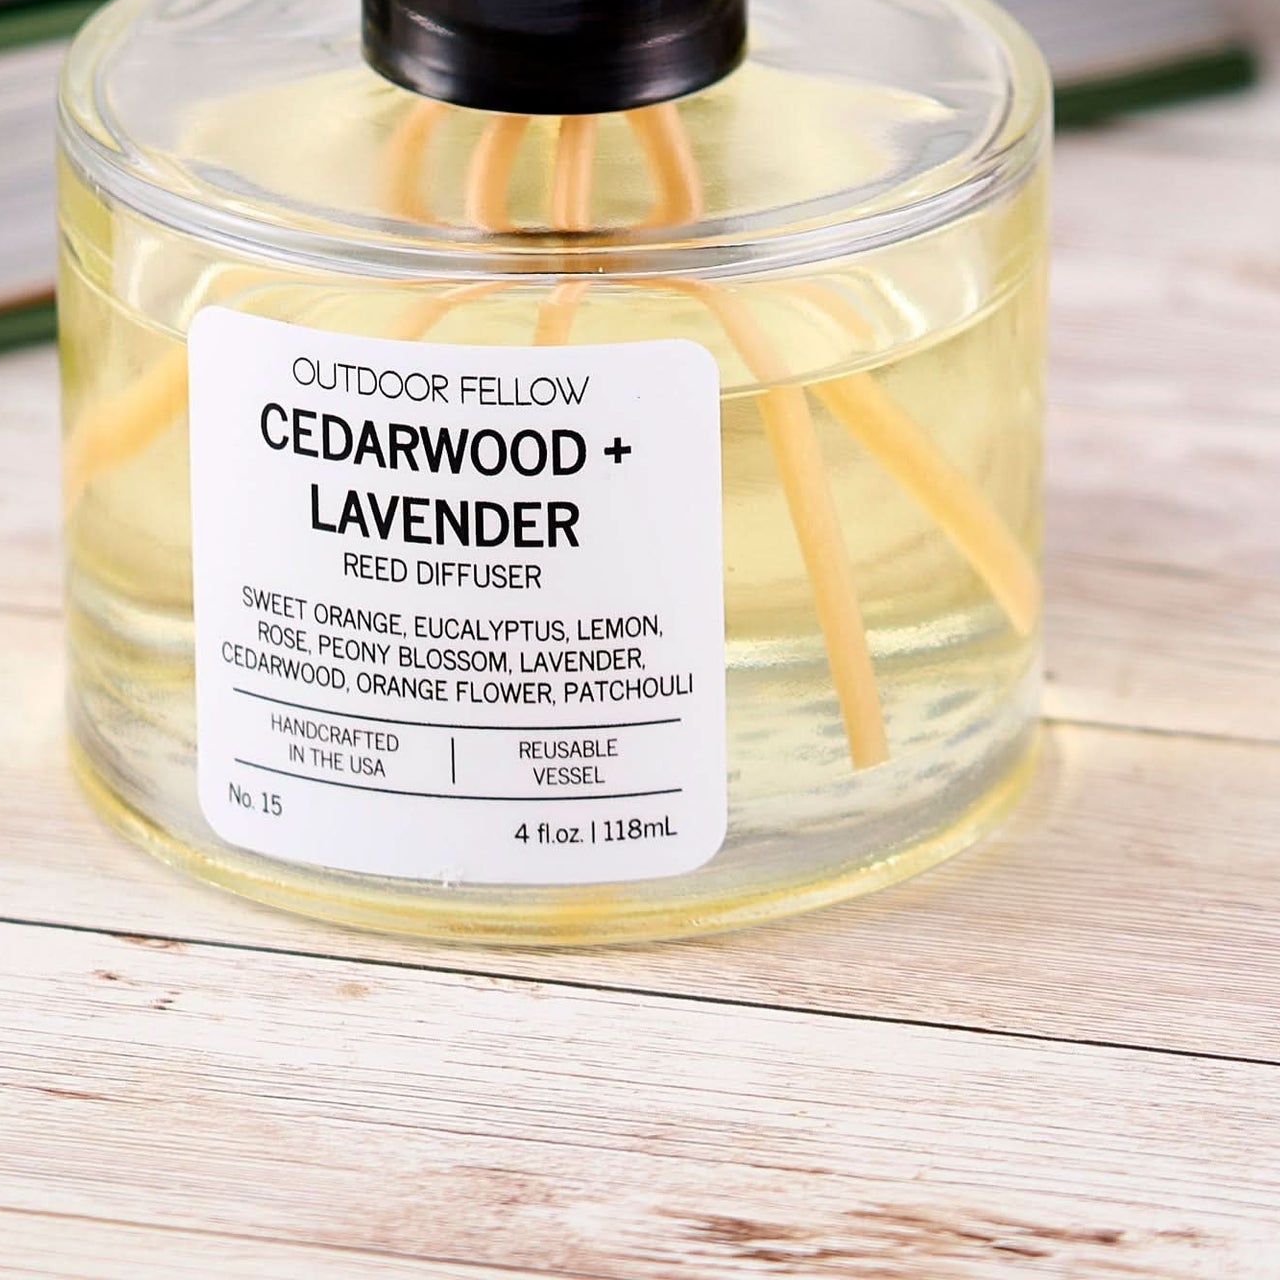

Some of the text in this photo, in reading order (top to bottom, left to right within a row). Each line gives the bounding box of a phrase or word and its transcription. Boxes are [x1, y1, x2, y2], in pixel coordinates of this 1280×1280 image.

[292, 356, 590, 406] OUTDOOR FELLOW
[260, 402, 632, 477] CEDARWOOD +
[310, 483, 580, 549] LAVENDER
[343, 552, 542, 589] REED DIFFUSER
[242, 585, 663, 644] SWEET ORANGE, EUCALYPTUS, LEMON,
[257, 620, 646, 676] ROSE, PEONY BLOSSOM, LAVENDER,
[221, 641, 693, 707] CEDARWOOD, ORANGE FLOWER, PATCHOULI
[270, 713, 400, 753] HANDCRAFTED
[519, 738, 619, 760] REUSABLE
[288, 743, 386, 778] IN THE USA
[532, 765, 606, 786] VESSEL
[228, 782, 283, 816] No. 15
[514, 822, 530, 844] 4
[536, 822, 584, 844] fl.oz.
[603, 815, 678, 842] 118mL
